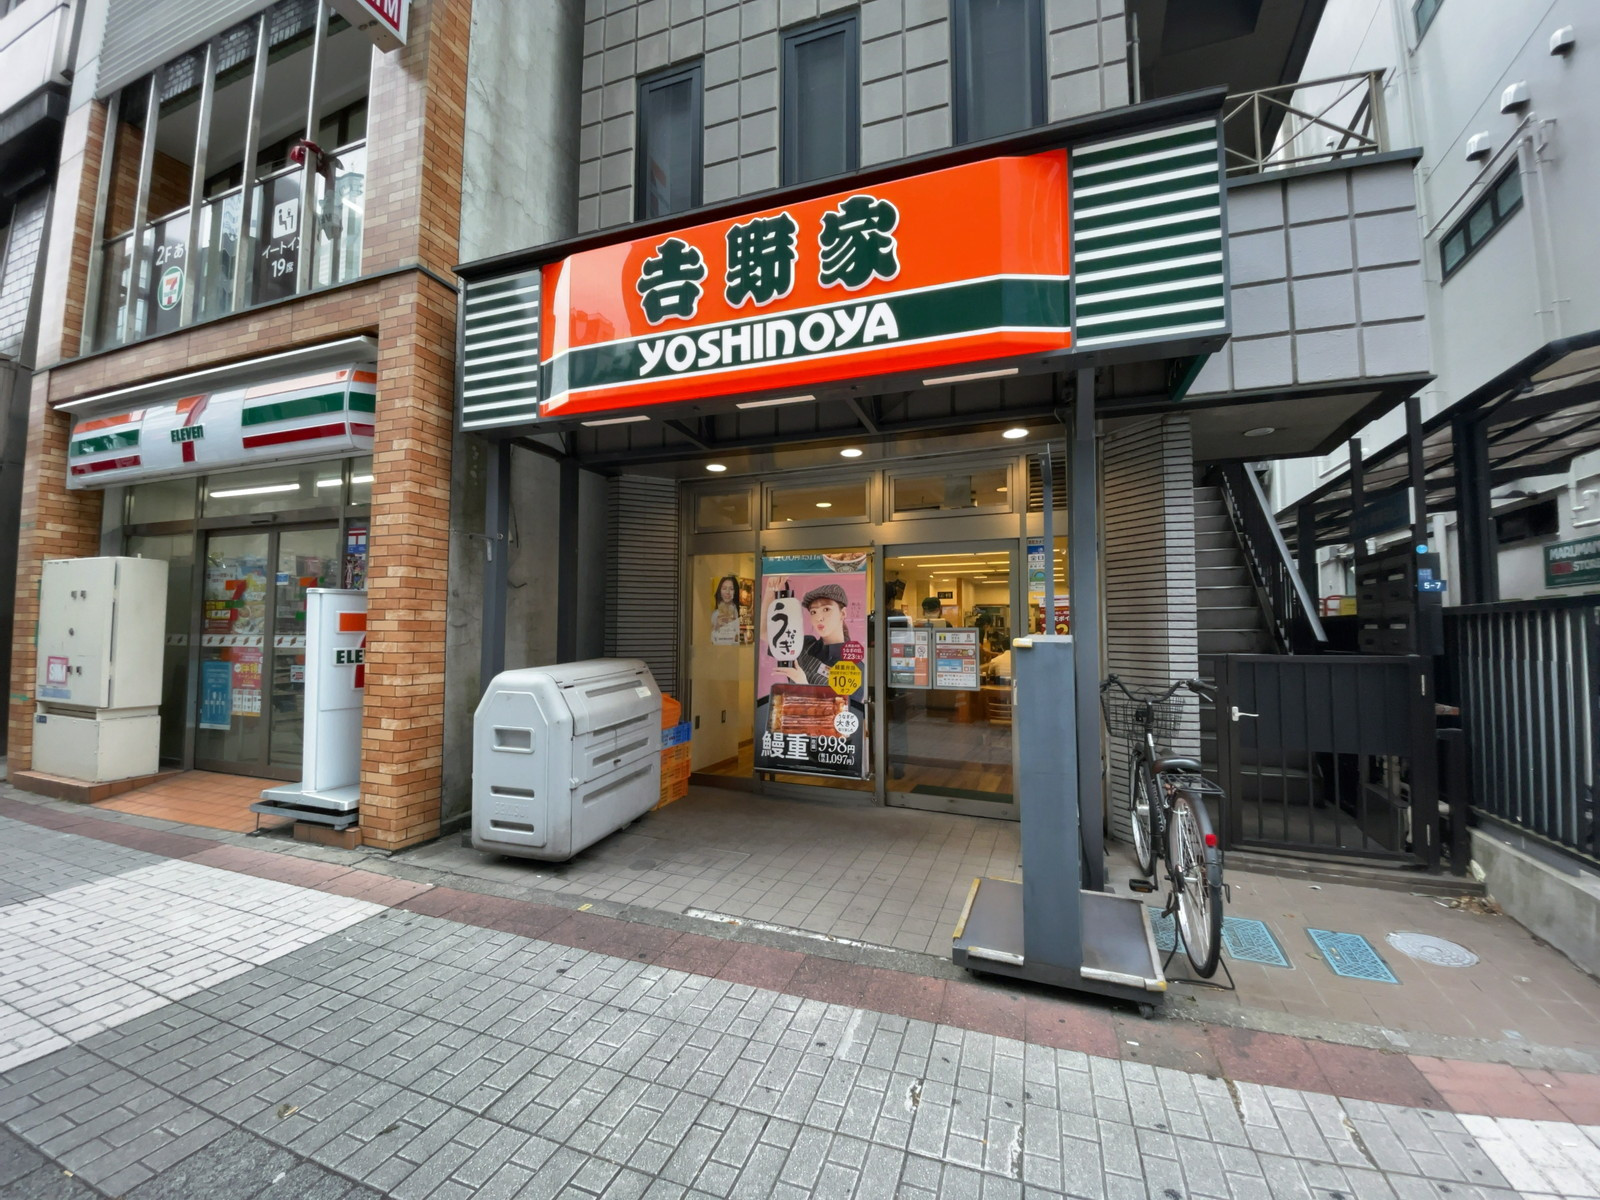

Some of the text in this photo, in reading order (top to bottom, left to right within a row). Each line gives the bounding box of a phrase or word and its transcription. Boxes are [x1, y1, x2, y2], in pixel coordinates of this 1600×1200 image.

[636, 193, 900, 326] 吉野家
[1423, 582, 1442, 590] 5-7
[770, 602, 797, 656] うなぎ
[336, 650, 364, 664] ELE
[833, 676, 858, 688] 10%
[836, 719, 856, 728] 大きく
[761, 731, 809, 760] 鰻重
[818, 734, 856, 754] 998円
